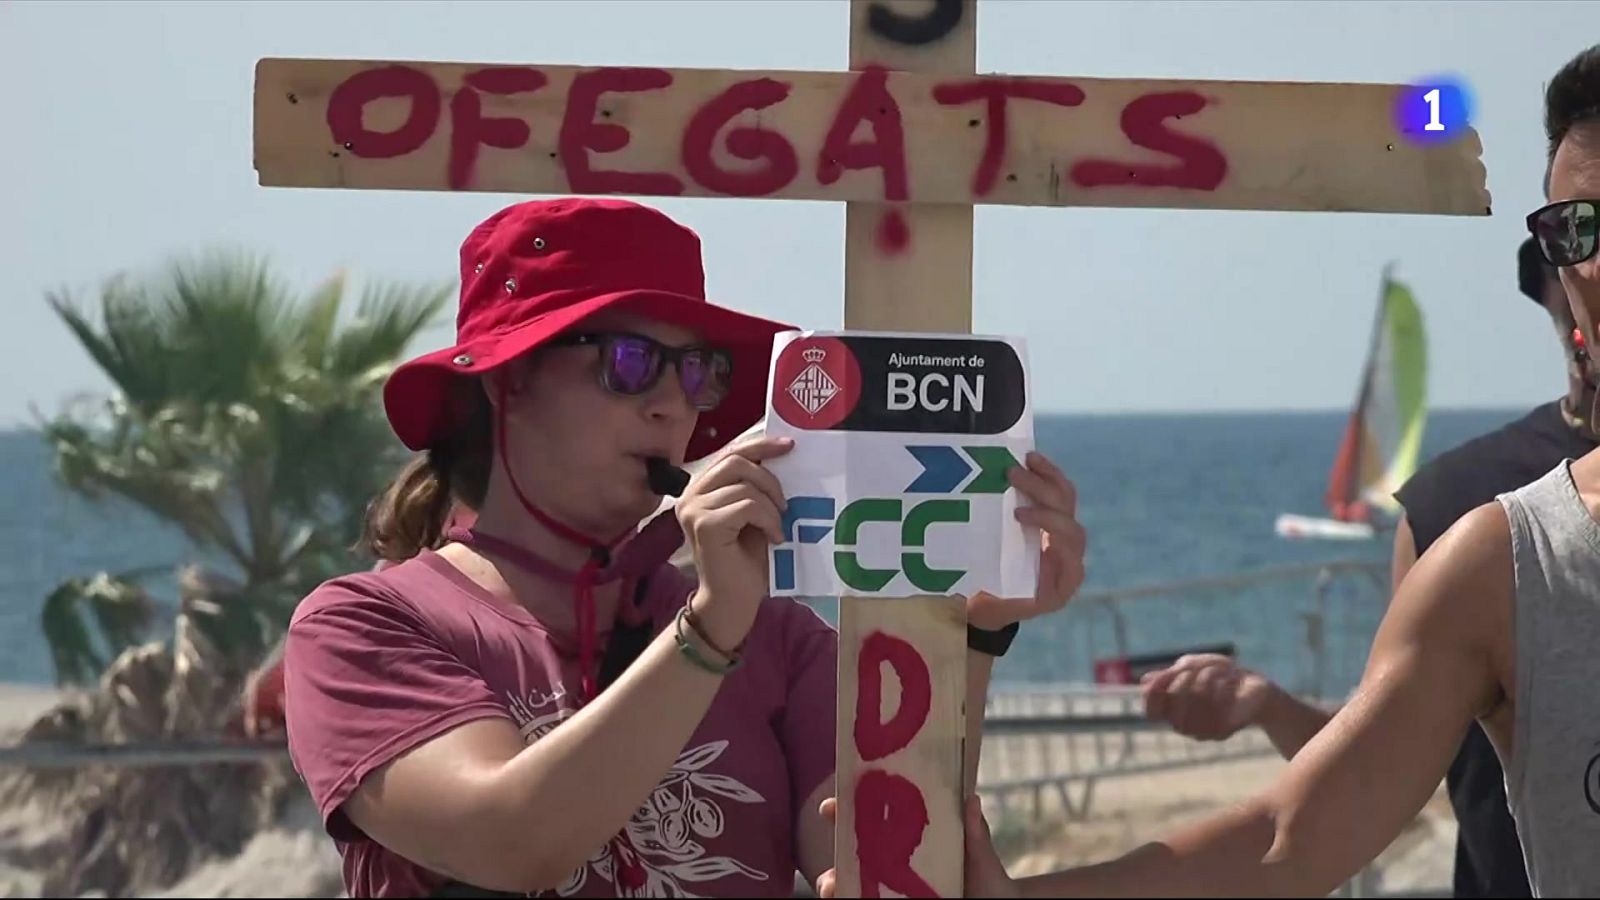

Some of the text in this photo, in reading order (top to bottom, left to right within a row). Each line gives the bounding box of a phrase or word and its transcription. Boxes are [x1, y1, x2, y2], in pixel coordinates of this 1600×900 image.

[327, 65, 1228, 202] OFEGATS
[886, 372, 985, 412] BCN
[888, 352, 985, 369] Ajuntament de
[773, 496, 970, 592] FCC
